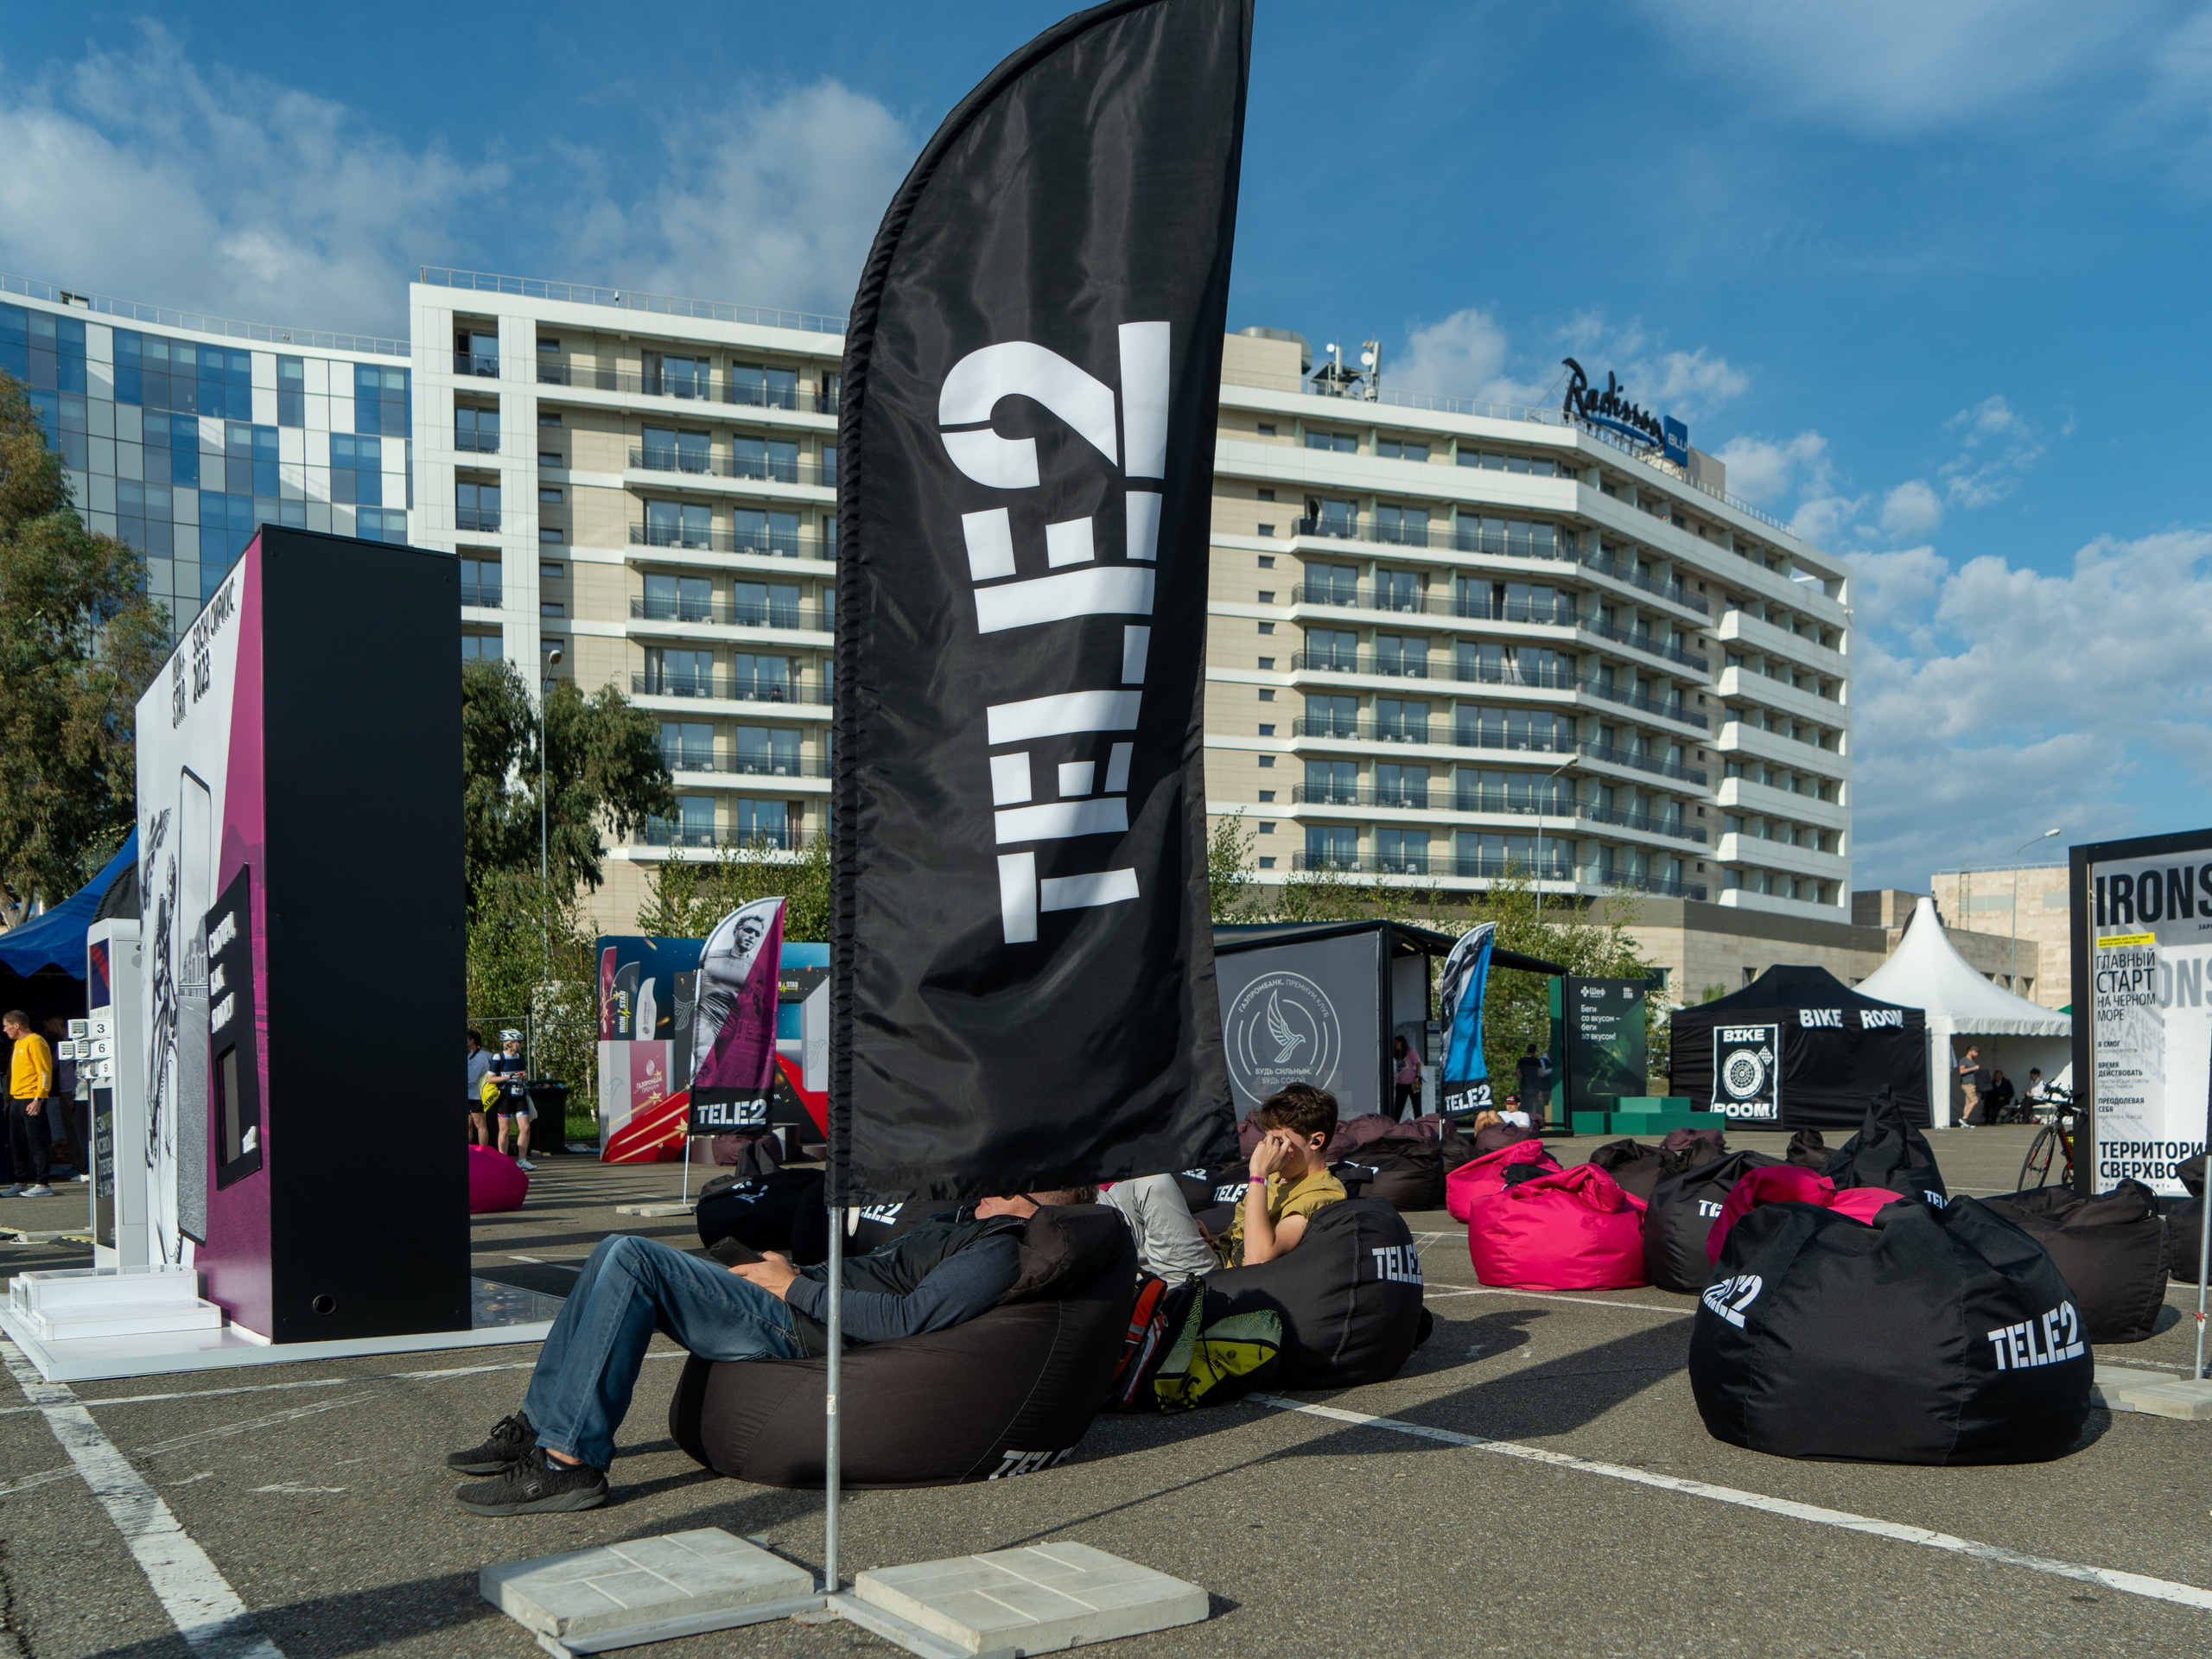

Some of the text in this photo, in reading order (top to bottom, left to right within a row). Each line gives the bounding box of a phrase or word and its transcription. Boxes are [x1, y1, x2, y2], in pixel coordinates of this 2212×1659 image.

[1562, 357, 1687, 453] Radisson BLU
[938, 321, 1171, 944] TELE2
[193, 648, 211, 704] 2023
[2096, 948, 2155, 969] ГЛАВНЫЙ
[2096, 968, 2155, 994] СТАРТ
[1238, 979, 1330, 1018] ГАЗПРОМБАНК. ПРЕМИУМ КЛУБ
[2097, 993, 2156, 1008] НА ЧЕРНОМ
[1580, 1004, 1597, 1013] Беги
[2097, 1008, 2125, 1021] МОРЕ
[1799, 1009, 1843, 1028] BIKE
[1859, 1009, 1904, 1029] ROOM
[97, 1024, 105, 1033] 3
[1591, 1033, 1616, 1041] вкусом!
[1723, 1029, 1765, 1042] BIKE
[99, 1044, 105, 1052] 6
[104, 1064, 109, 1072] 9
[2098, 1069, 2143, 1077] ДЕЙСТВОВАТЬ
[1445, 1084, 1492, 1111] TELE2
[697, 1099, 767, 1125] TELE2
[1987, 1300, 2085, 1370] TELE2
